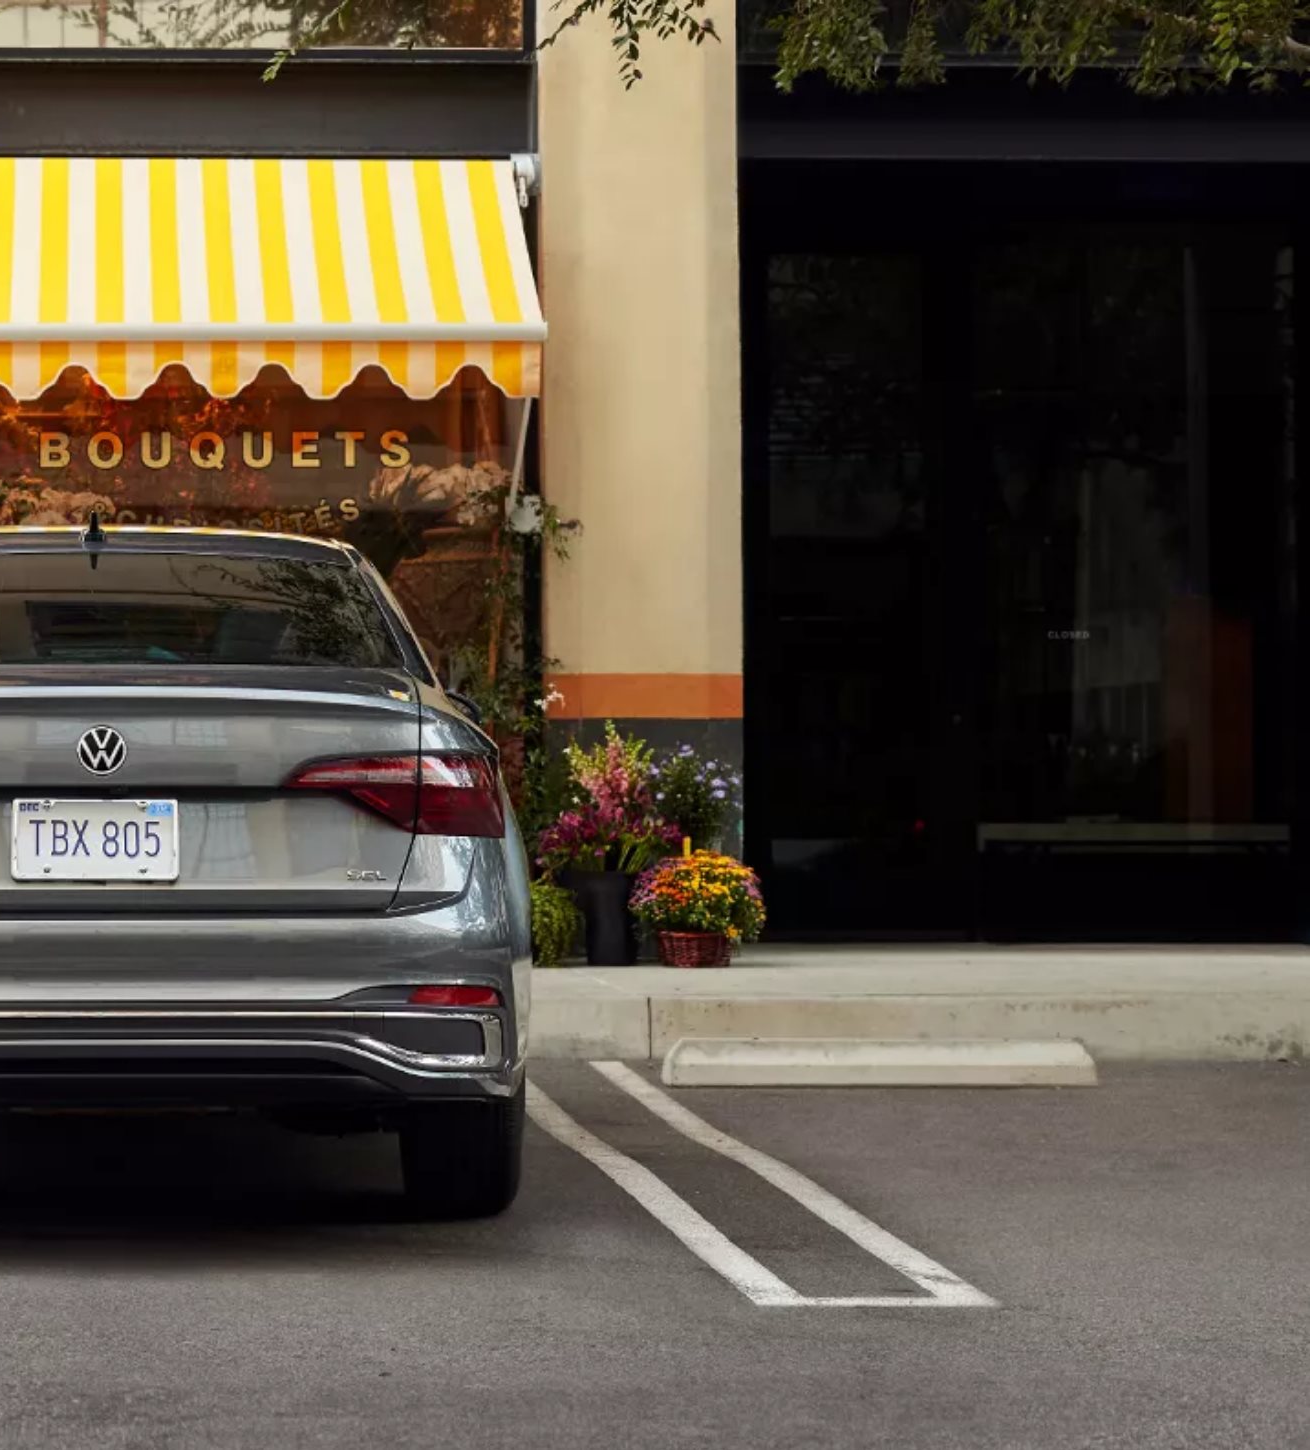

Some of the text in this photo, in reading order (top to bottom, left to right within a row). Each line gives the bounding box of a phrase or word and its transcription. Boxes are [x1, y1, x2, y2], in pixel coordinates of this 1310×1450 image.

[40, 430, 411, 470] BOUQUETS
[1047, 630, 1090, 640] CLOSED
[19, 803, 40, 812] DEC
[29, 819, 161, 858] TBX 805
[346, 869, 387, 881] SEL
